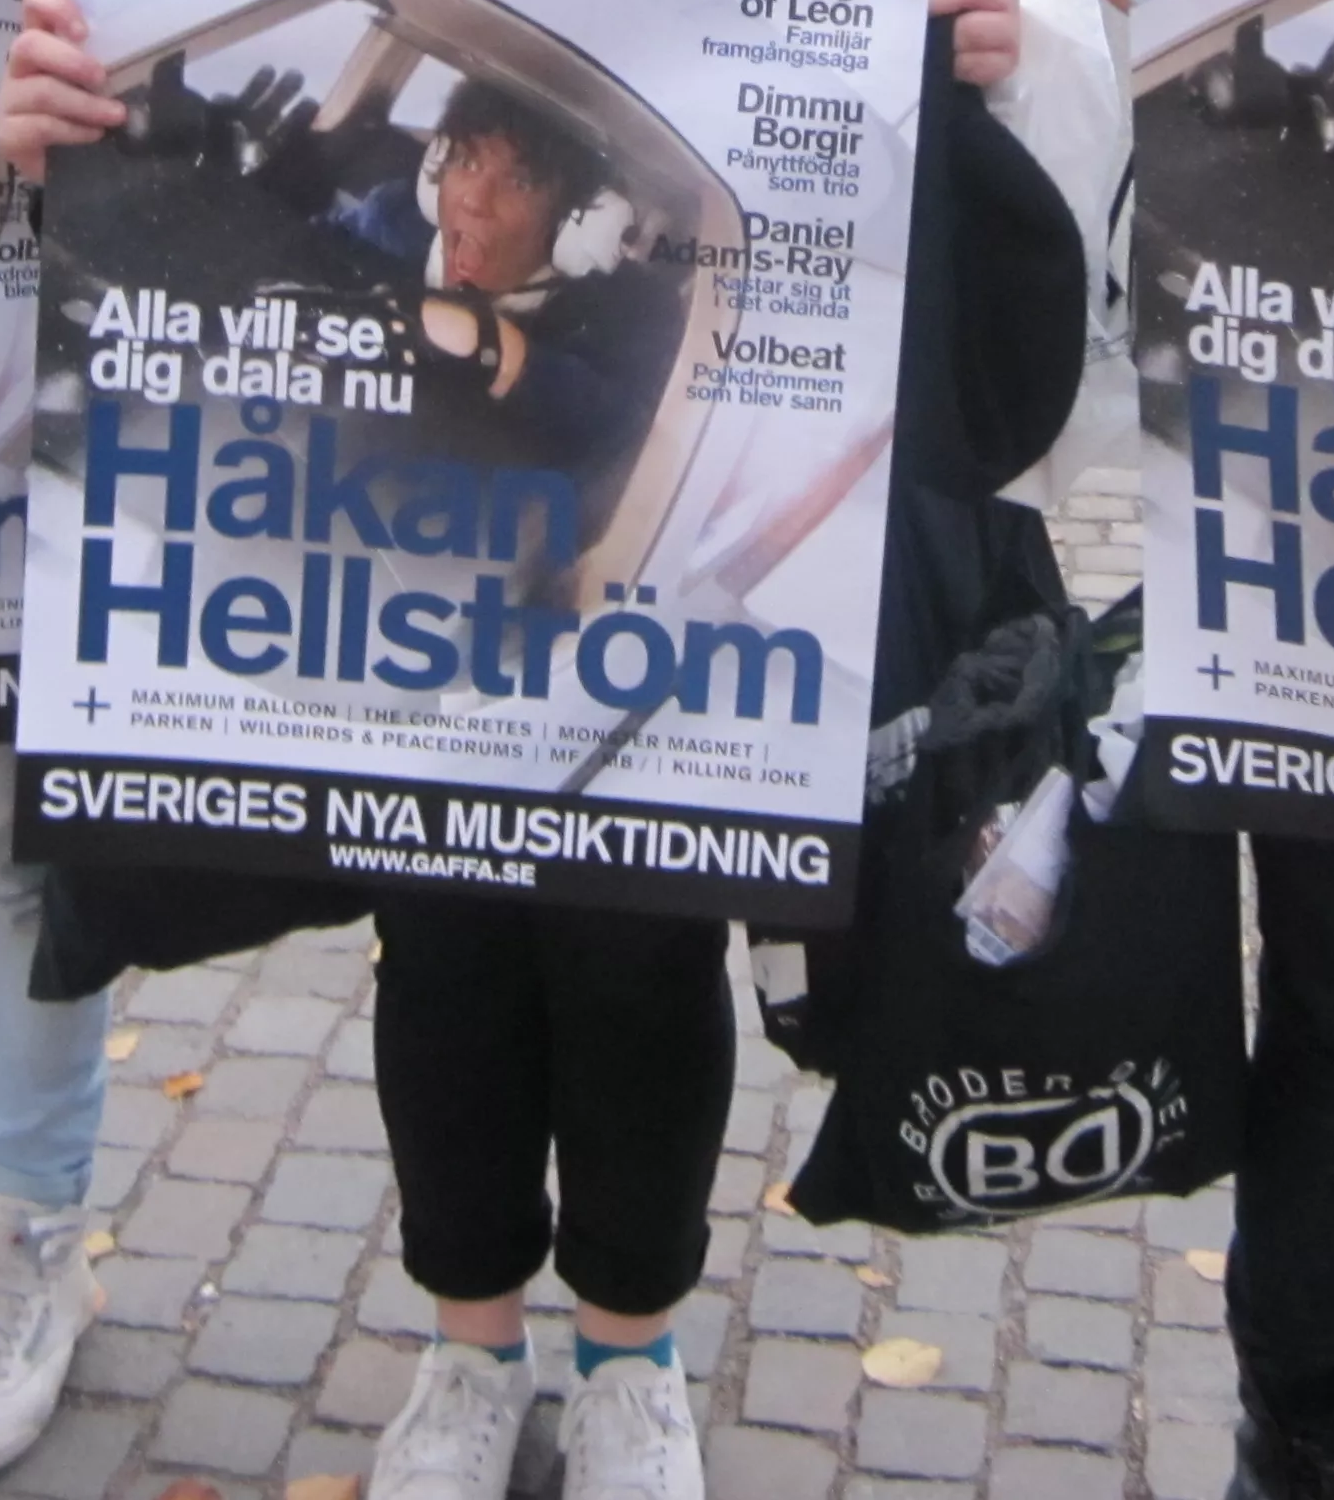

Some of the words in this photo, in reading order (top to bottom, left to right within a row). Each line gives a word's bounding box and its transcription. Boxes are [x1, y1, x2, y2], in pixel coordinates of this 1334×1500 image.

[701, 36, 869, 73] framgångssaga
[786, 25, 873, 53] Familjär
[737, 82, 865, 124] Dimmu
[752, 116, 864, 159] Borgir
[727, 148, 861, 178] Pånyttfödda
[768, 175, 816, 194] som
[823, 177, 859, 197] trio
[744, 211, 855, 250] Daniel
[648, 233, 854, 284] Adams-Ray
[713, 273, 784, 297] Kastar
[790, 279, 823, 300] sig
[829, 283, 852, 301] ut
[726, 291, 764, 311] det
[769, 294, 851, 320] okända
[1184, 261, 1294, 324] Alla
[88, 286, 200, 344] Alla
[220, 298, 298, 351] vill
[315, 311, 385, 360] se
[712, 329, 847, 372] Volbeat
[1187, 313, 1278, 382] dig
[89, 339, 183, 404] dig
[202, 346, 323, 405] dala
[343, 369, 414, 414] nu
[686, 383, 732, 402] som
[739, 387, 783, 408] blev
[790, 393, 843, 413] sann
[692, 362, 844, 394] Pojkdrömmen
[82, 394, 579, 573] Håkan
[75, 536, 824, 727] Hellström
[131, 688, 236, 712] MAXIMUM
[243, 694, 338, 720] BALLOON
[363, 707, 400, 726] THE
[408, 710, 532, 738] CONCRETES
[668, 736, 755, 761] MAGNET
[129, 712, 214, 732] PARKEN
[238, 719, 354, 744] WILDBIRDS
[361, 729, 375, 746] &
[381, 731, 524, 761] PEACEDRUMS
[672, 759, 752, 783] KILLING
[758, 768, 812, 789] JOKE
[40, 767, 308, 833] SVERIGES
[324, 786, 427, 846] NYA
[444, 795, 831, 887] MUSIKTIDNING
[329, 842, 537, 887] WWW.GAFFA.SE
